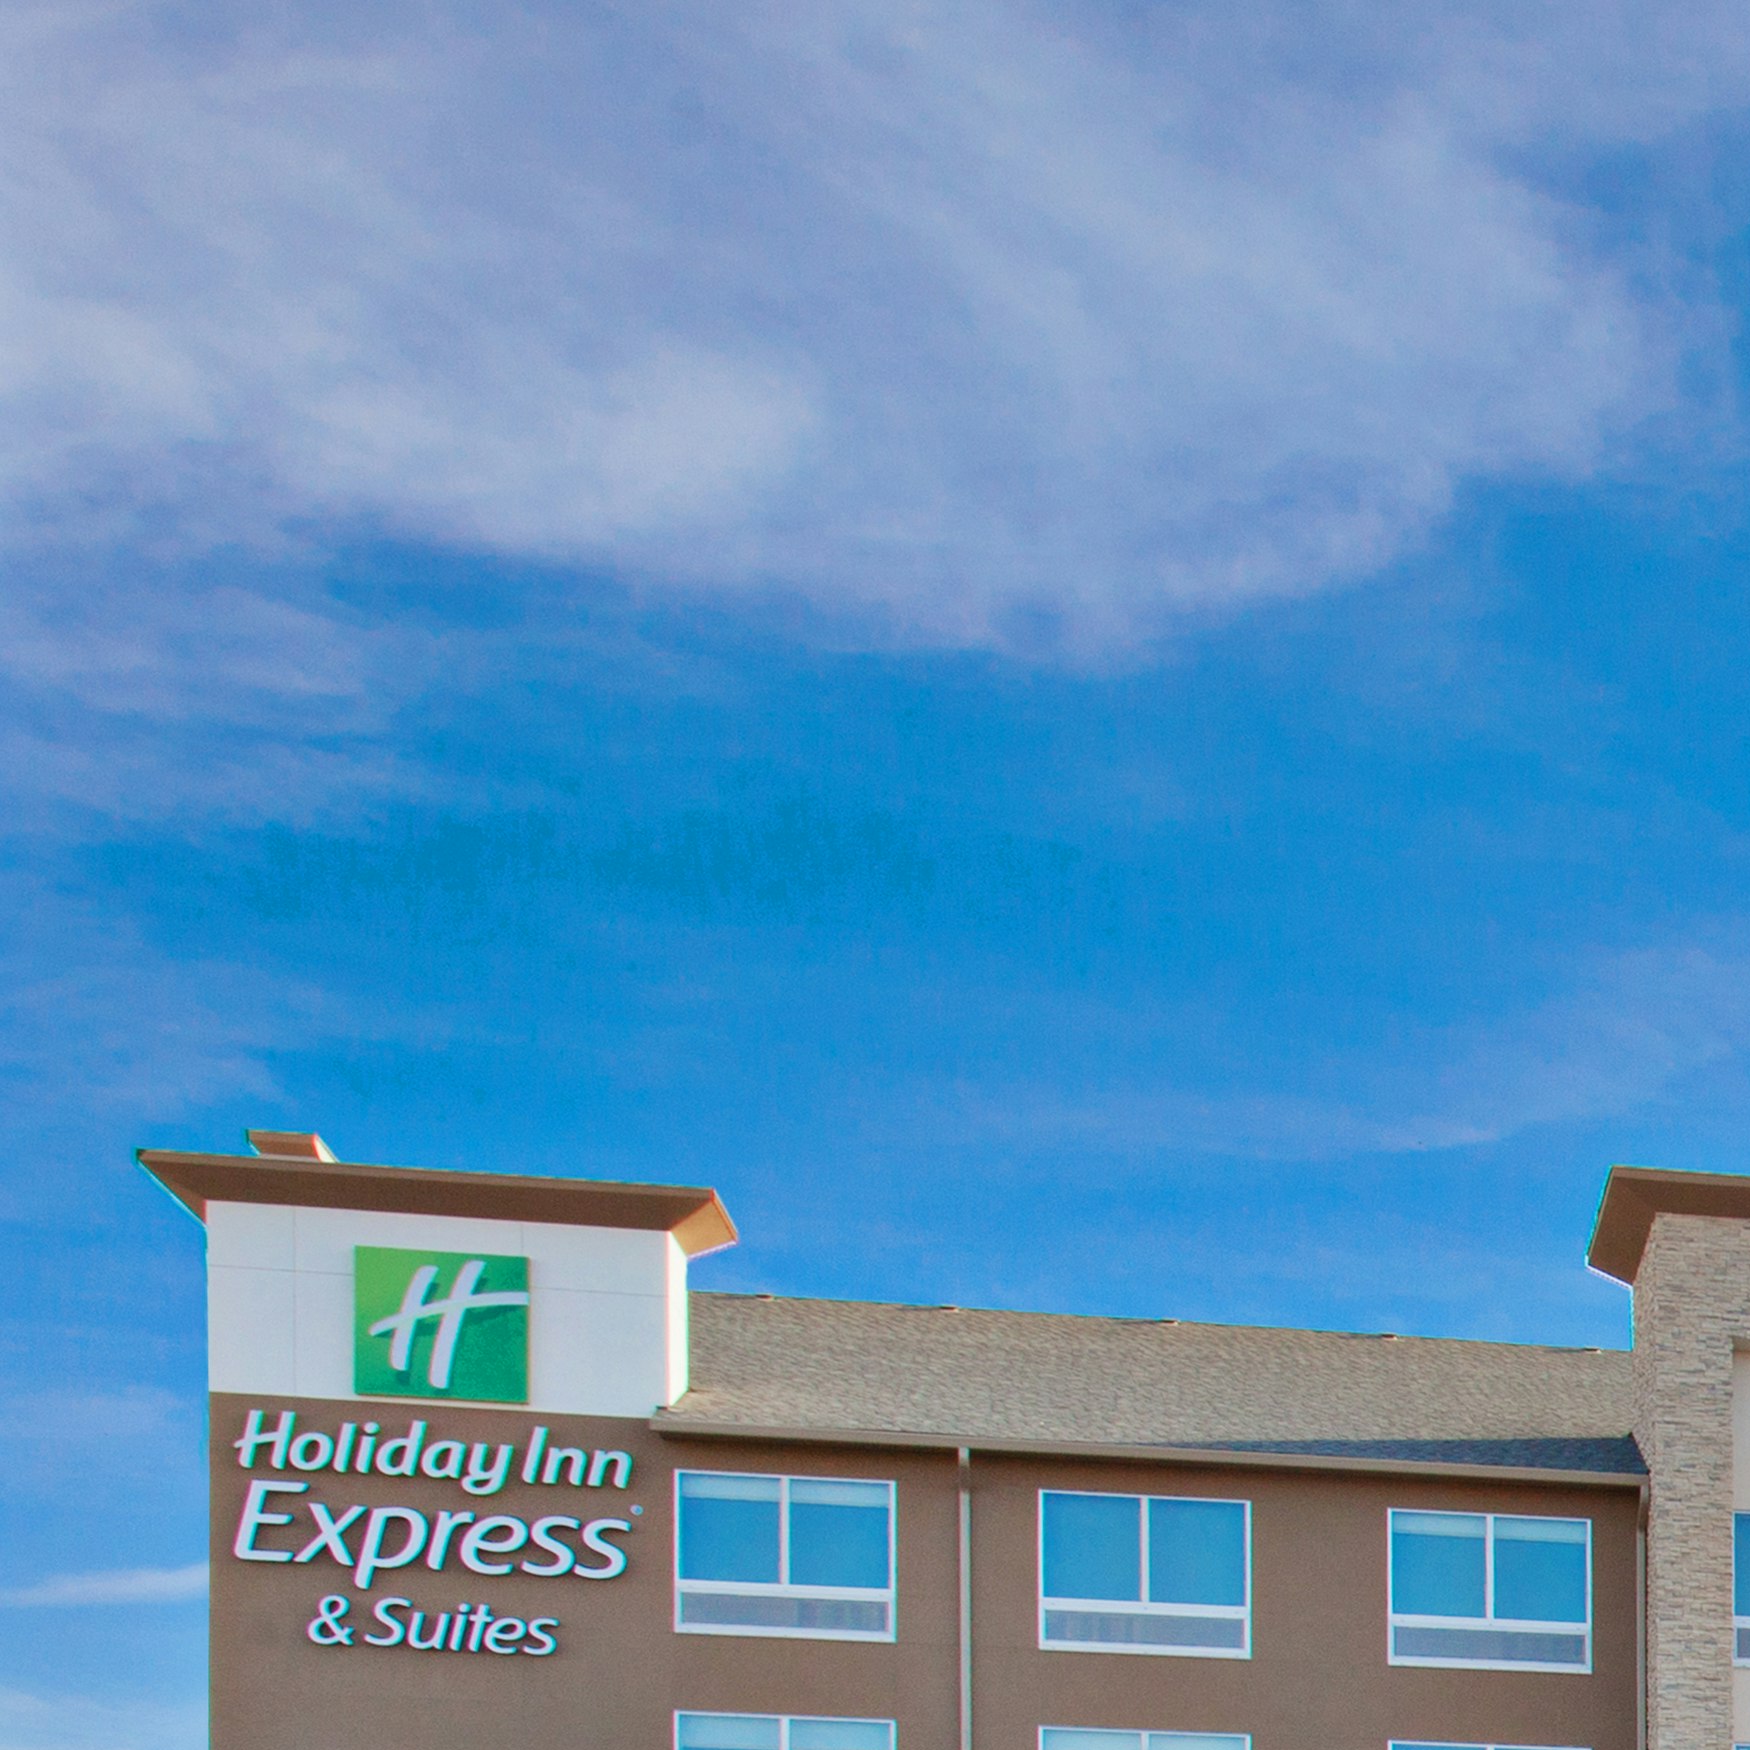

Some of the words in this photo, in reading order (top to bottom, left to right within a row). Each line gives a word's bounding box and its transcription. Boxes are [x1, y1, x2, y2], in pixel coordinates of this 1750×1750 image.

[233, 1409, 514, 1496] Holiday
[521, 1425, 633, 1489] Inn
[233, 1479, 633, 1590] Express
[307, 1594, 354, 1646] &
[364, 1596, 560, 1656] Suites
